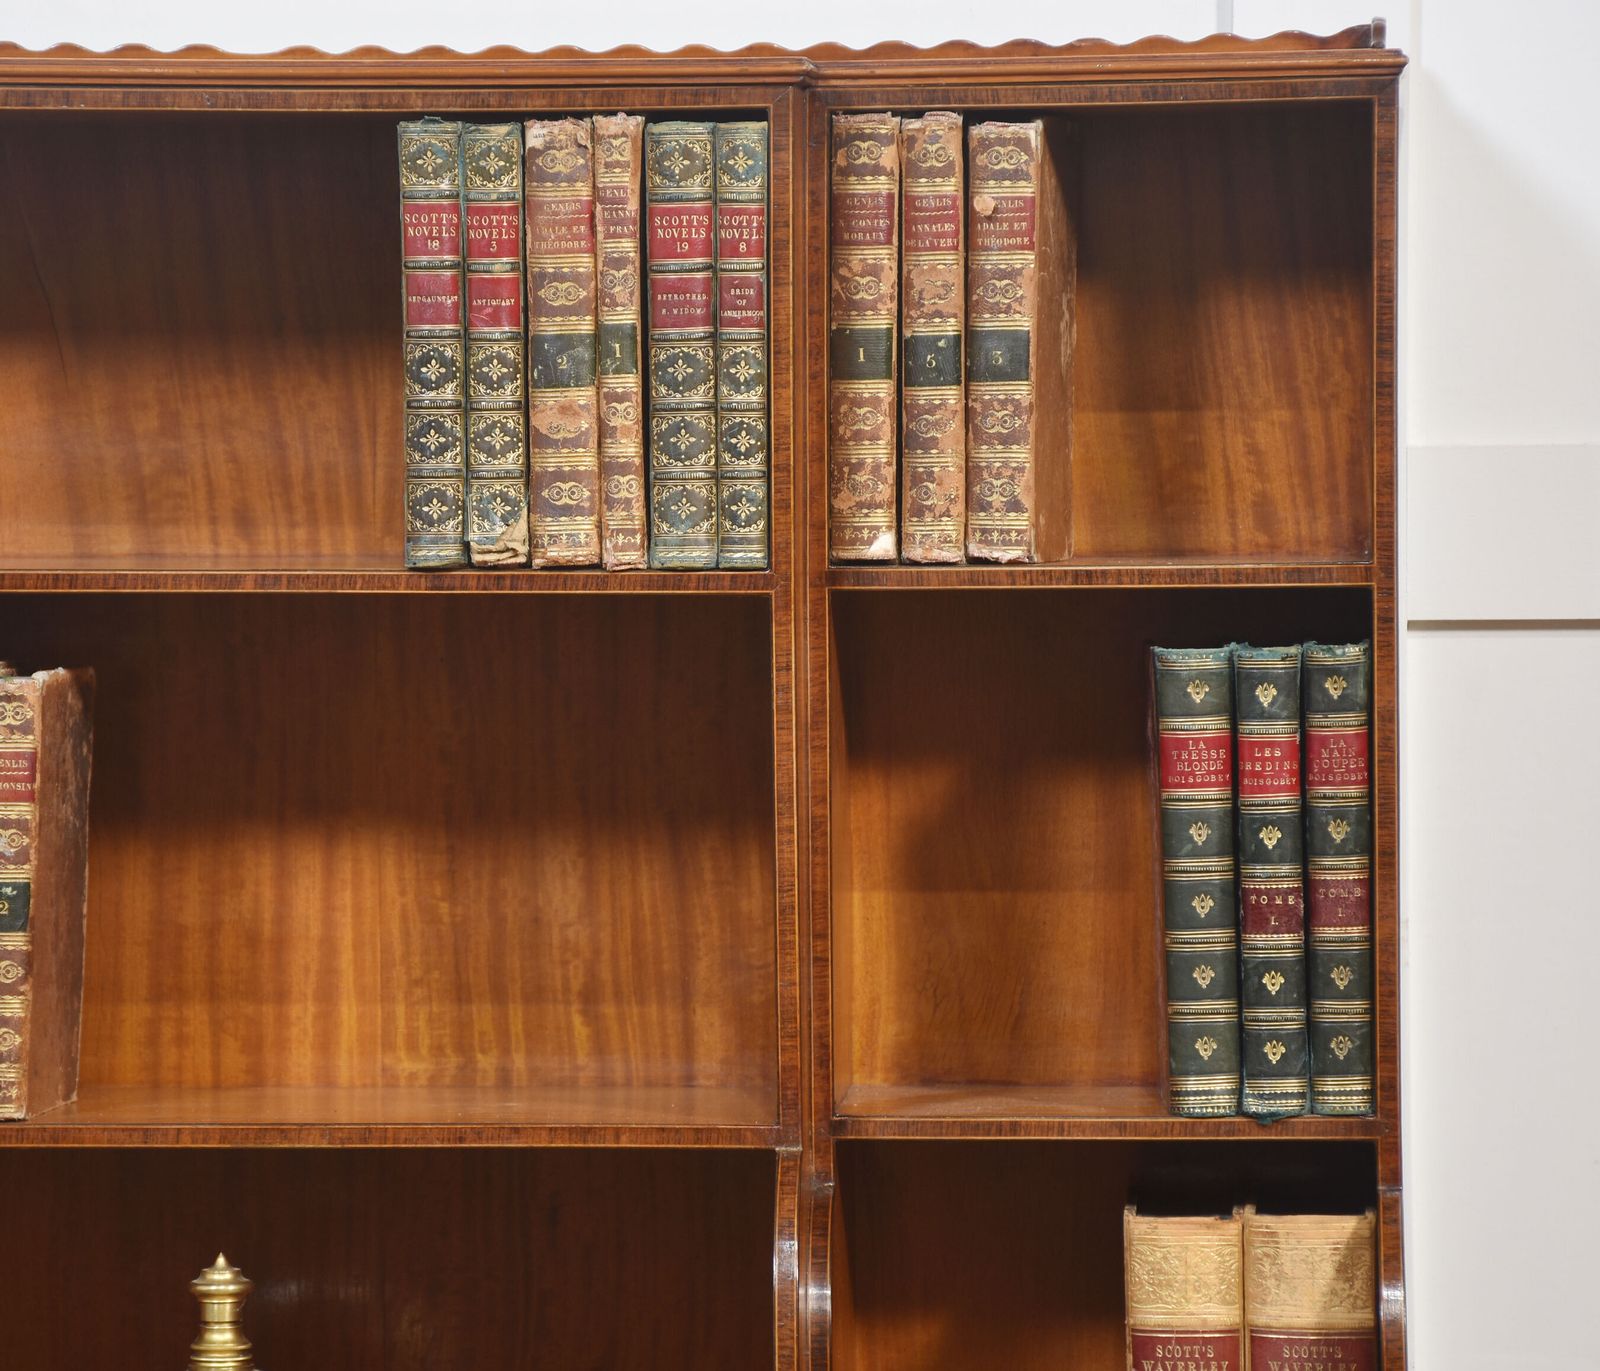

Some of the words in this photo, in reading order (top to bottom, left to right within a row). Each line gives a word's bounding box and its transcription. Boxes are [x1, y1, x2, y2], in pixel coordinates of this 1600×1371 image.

[405, 213, 458, 224] SCOTT'S
[467, 215, 518, 225] SCOTT'S
[655, 215, 709, 225] SCOTT'S
[1013, 222, 1026, 230] ET
[408, 226, 456, 237] NOVELS
[469, 228, 515, 239] NOVELS
[658, 228, 706, 238] NOVELS
[428, 240, 440, 250] 18
[490, 242, 497, 252] 3
[677, 242, 688, 252] 19
[739, 242, 747, 252] 8
[556, 356, 568, 369] 2
[926, 354, 936, 368] 5
[992, 351, 1002, 364] 3
[1189, 740, 1205, 749] LA
[1330, 739, 1346, 748] LA
[1172, 749, 1225, 760] TRESSE
[1255, 748, 1281, 757] LES
[1321, 747, 1356, 757] MAIN
[1177, 760, 1223, 770] BLONDE
[1243, 777, 1296, 786] BOISGOBEY
[1319, 887, 1361, 898] TOME
[1251, 895, 1295, 905] TOME
[1155, 1345, 1214, 1358] SCOTT'S
[1283, 1346, 1342, 1358] SCOTT'S
